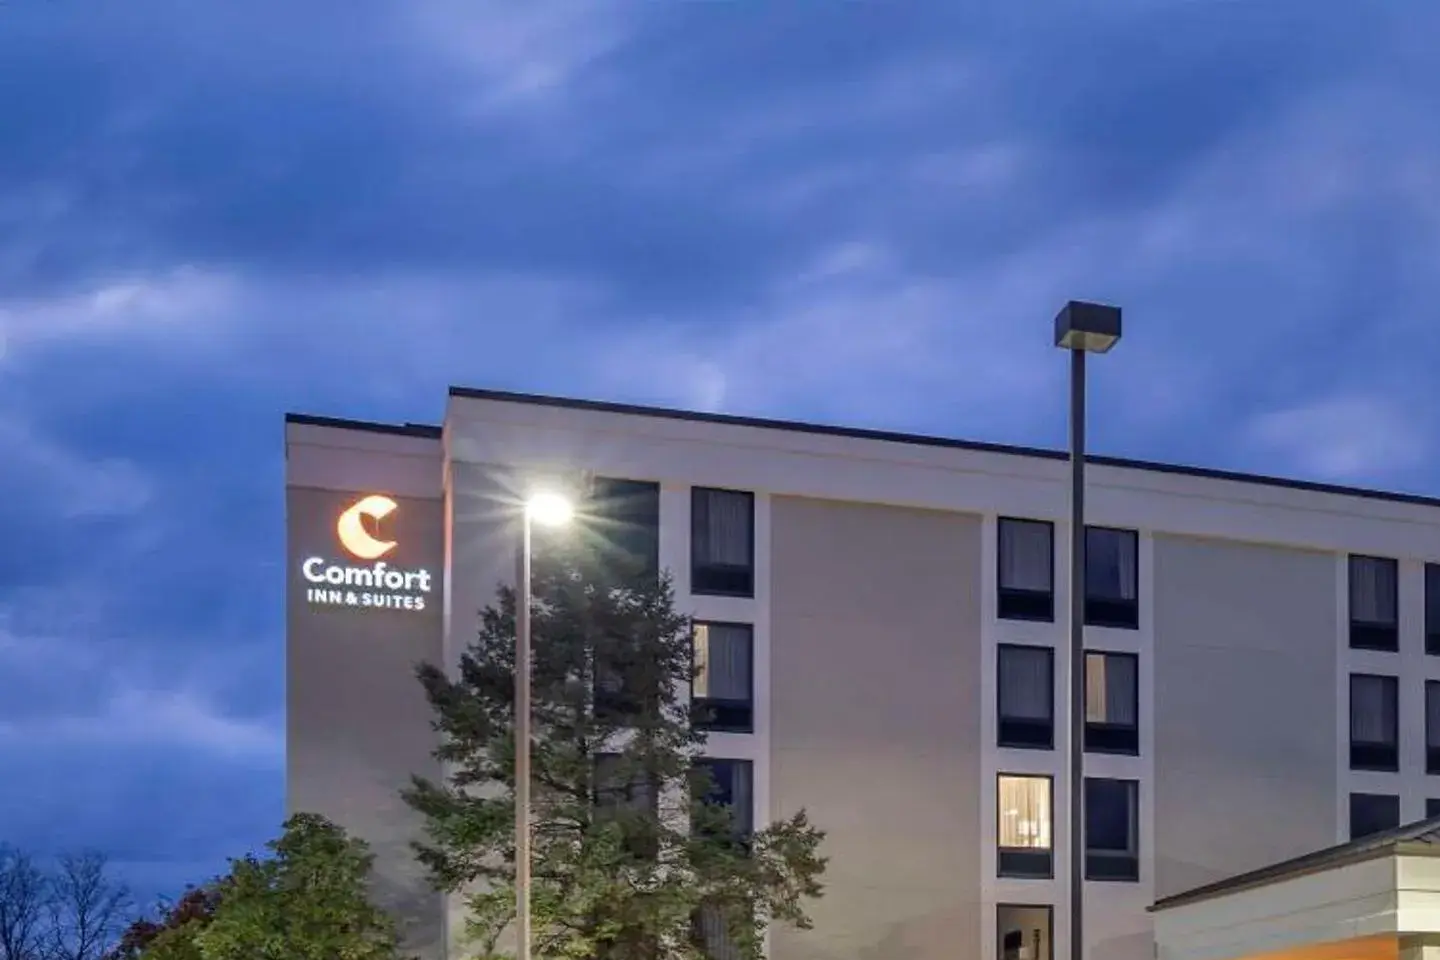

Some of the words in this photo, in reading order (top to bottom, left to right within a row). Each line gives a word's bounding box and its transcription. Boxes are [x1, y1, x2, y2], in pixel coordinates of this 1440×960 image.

[303, 557, 431, 591] Comfort
[307, 589, 341, 604] INN
[345, 591, 358, 606] &
[361, 592, 425, 610] SUITES
